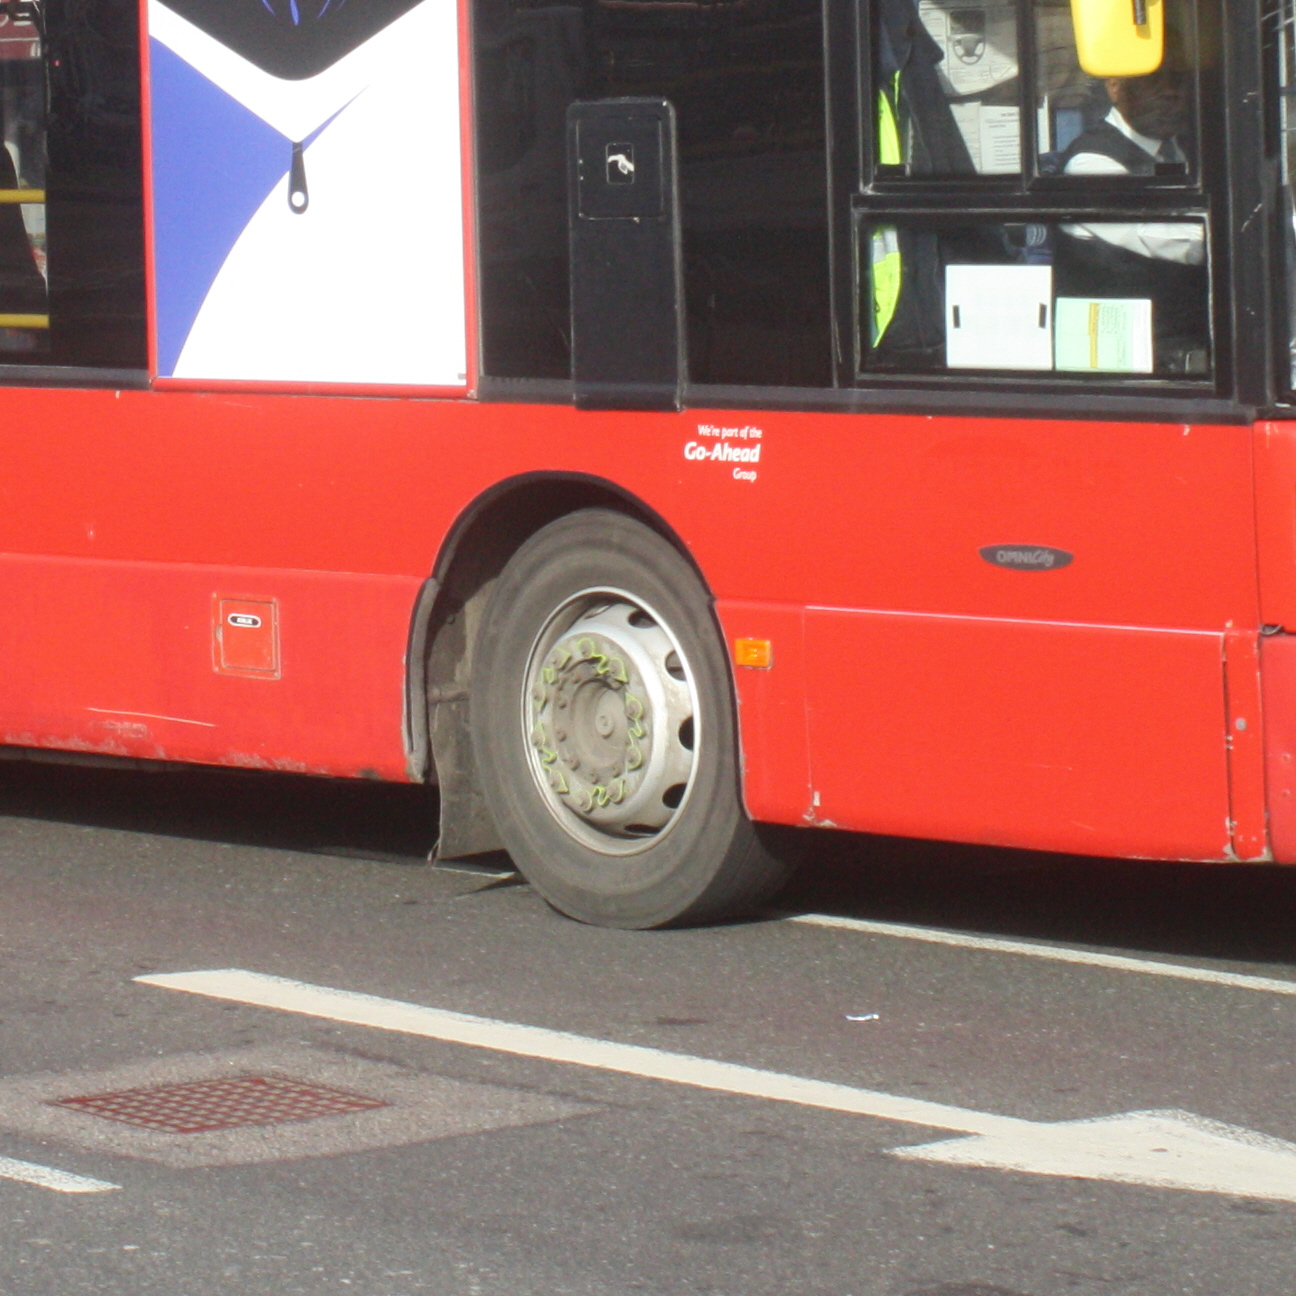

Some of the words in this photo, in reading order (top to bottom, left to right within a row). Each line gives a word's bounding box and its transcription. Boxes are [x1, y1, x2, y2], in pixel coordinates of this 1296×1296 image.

[721, 427, 739, 440] part
[739, 426, 750, 440] of
[749, 427, 763, 439] the
[684, 441, 762, 462] Go-Ahead
[732, 467, 758, 483] Group
